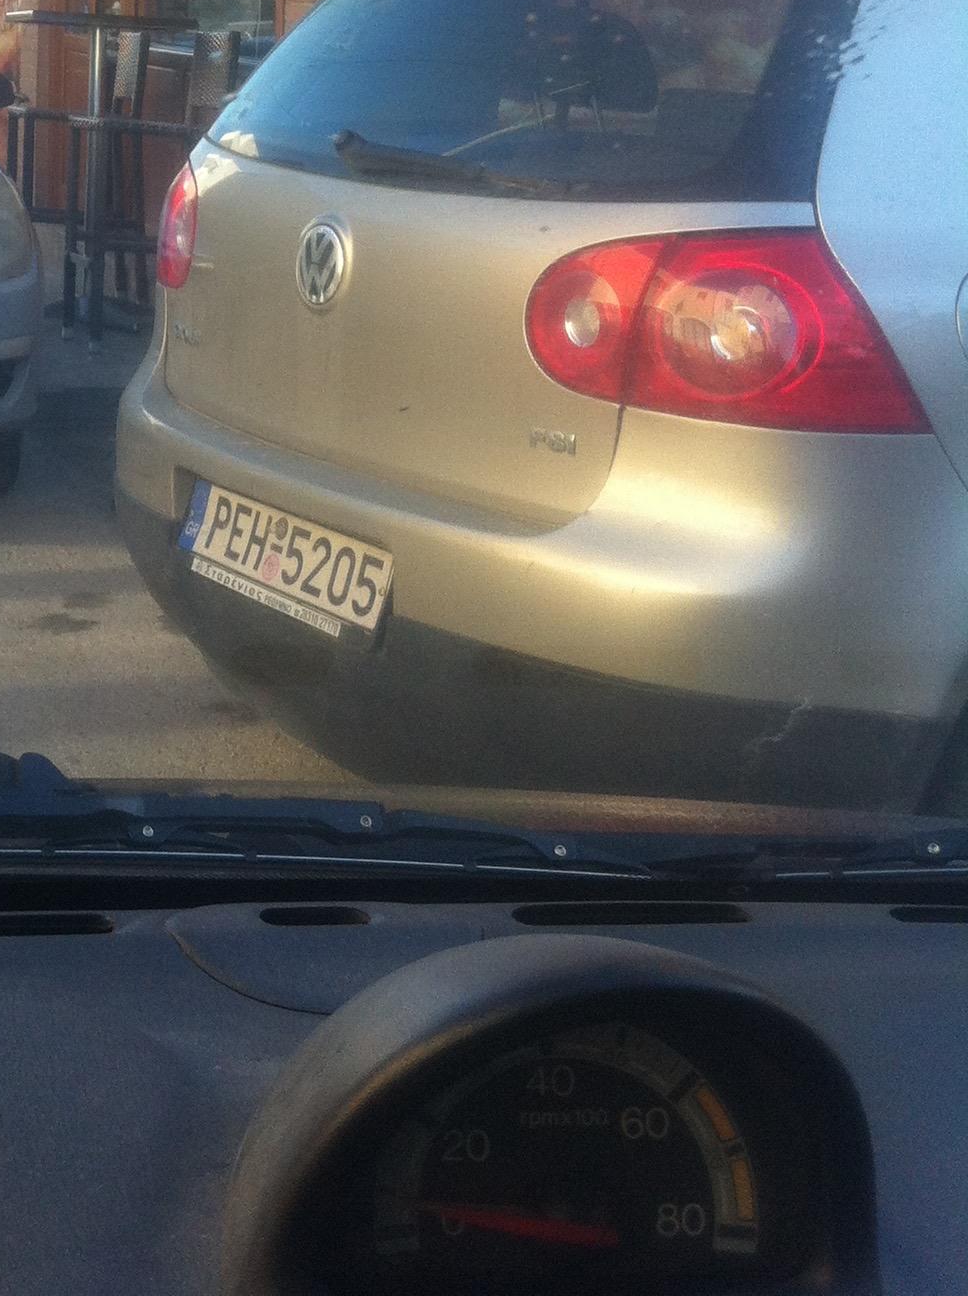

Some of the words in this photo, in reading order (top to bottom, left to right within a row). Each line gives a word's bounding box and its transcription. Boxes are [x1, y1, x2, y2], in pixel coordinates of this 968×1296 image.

[525, 1065, 575, 1097] 40
[621, 1107, 669, 1139] 60
[441, 1129, 490, 1162] 20
[656, 1203, 707, 1238] 80
